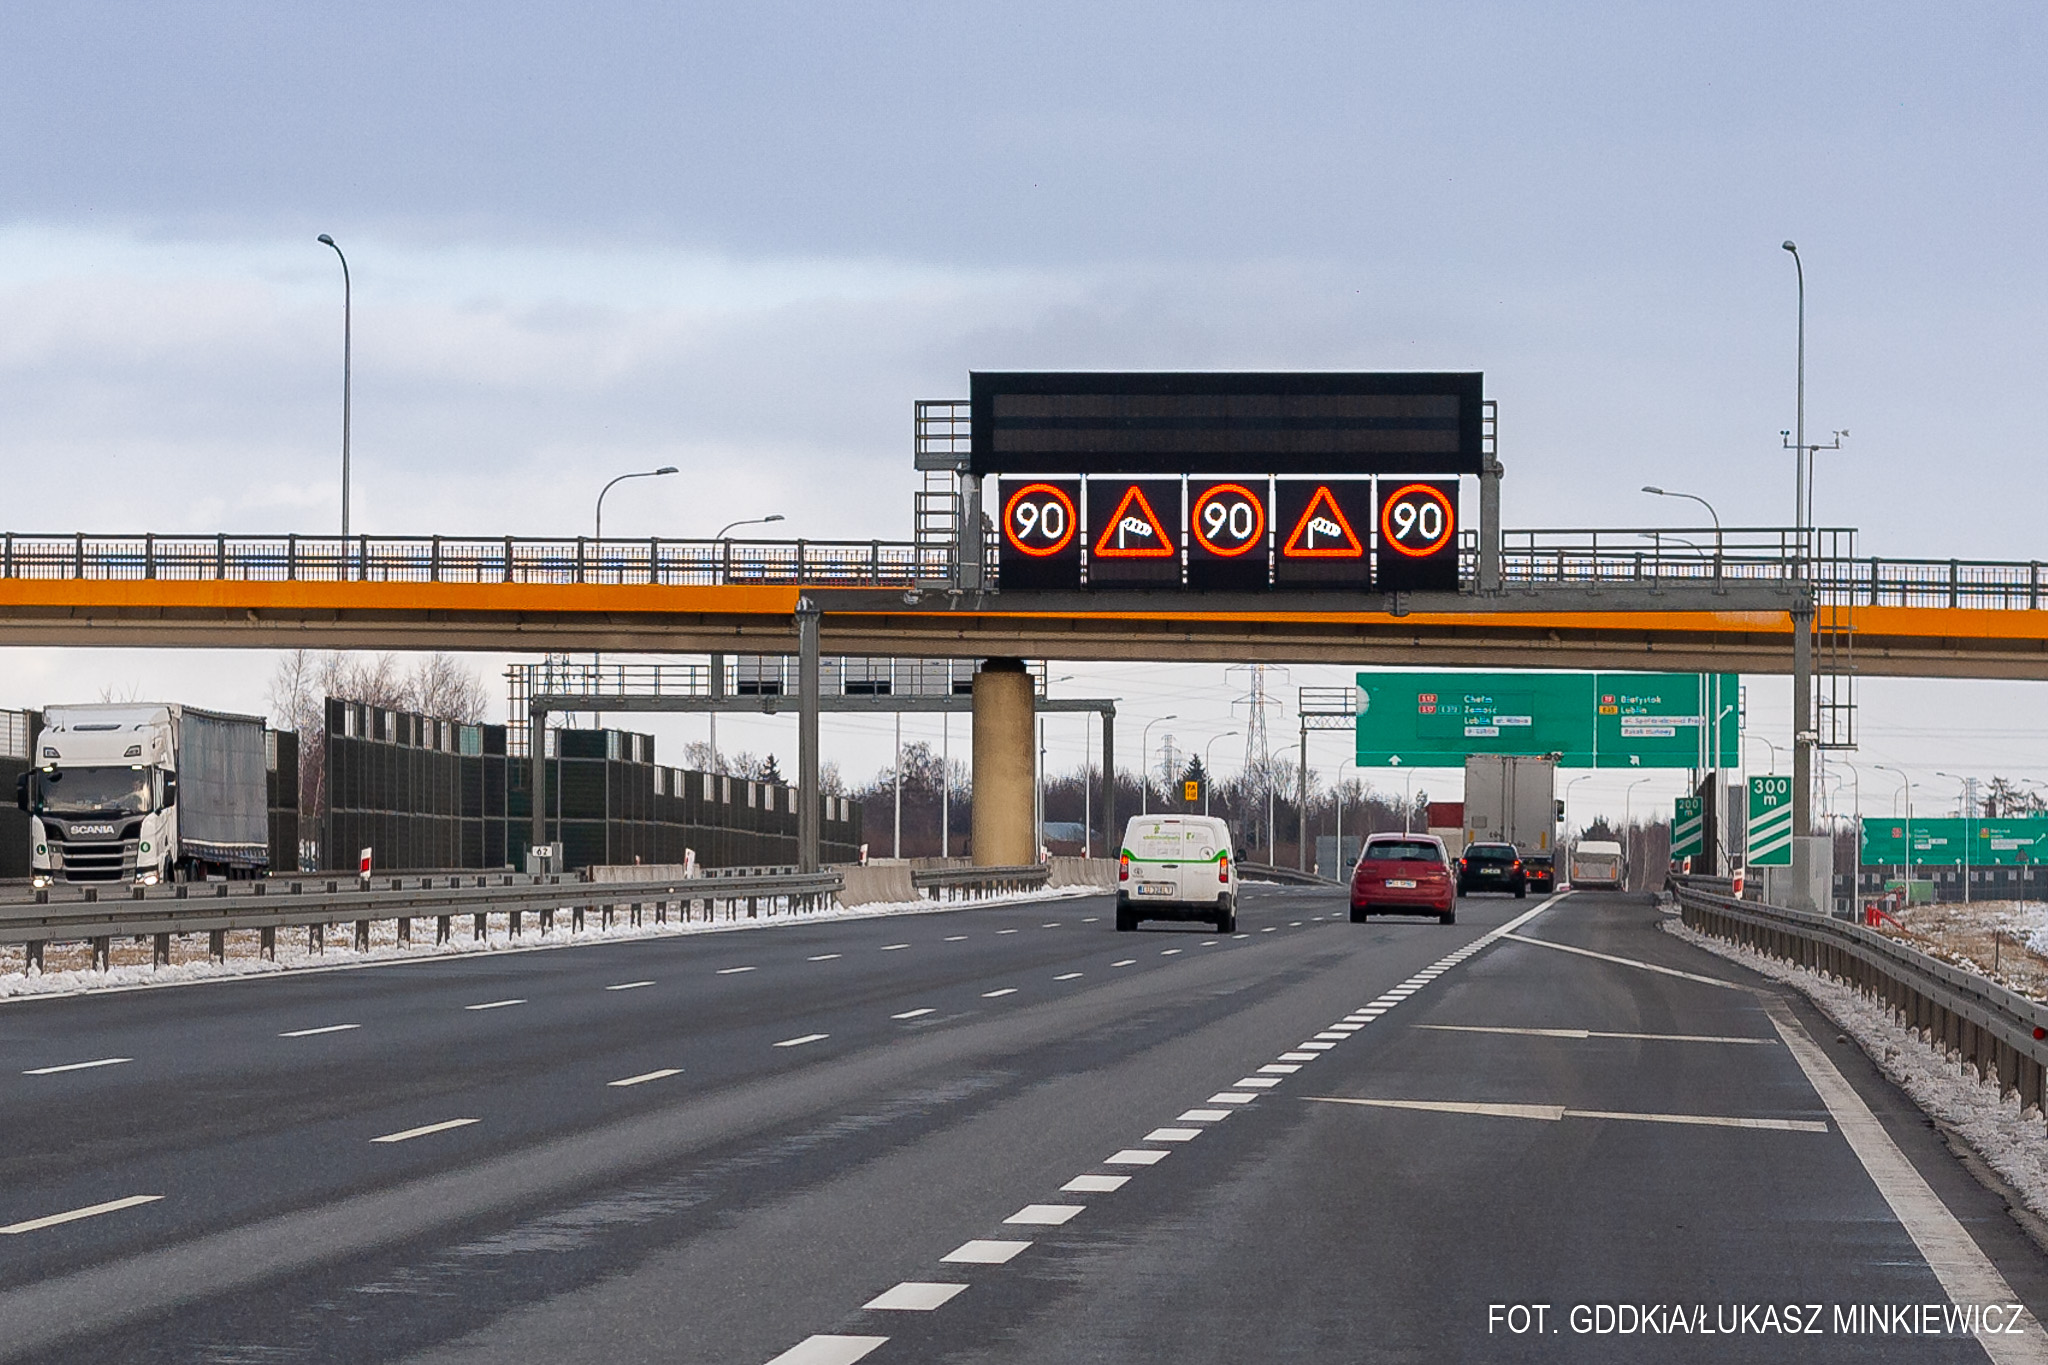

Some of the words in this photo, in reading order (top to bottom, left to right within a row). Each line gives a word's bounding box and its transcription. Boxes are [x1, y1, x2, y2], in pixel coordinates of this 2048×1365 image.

[1016, 502, 1064, 539] 90
[1204, 502, 1252, 539] 90
[1394, 502, 1442, 539] 90
[1621, 695, 1661, 705] Białystok
[1621, 706, 1647, 714] Lublin
[1464, 716, 1490, 725] Lublin
[1754, 779, 1787, 794] 300
[1679, 800, 1698, 809] 200
[1763, 794, 1777, 806] m
[70, 824, 115, 835] SCANIA
